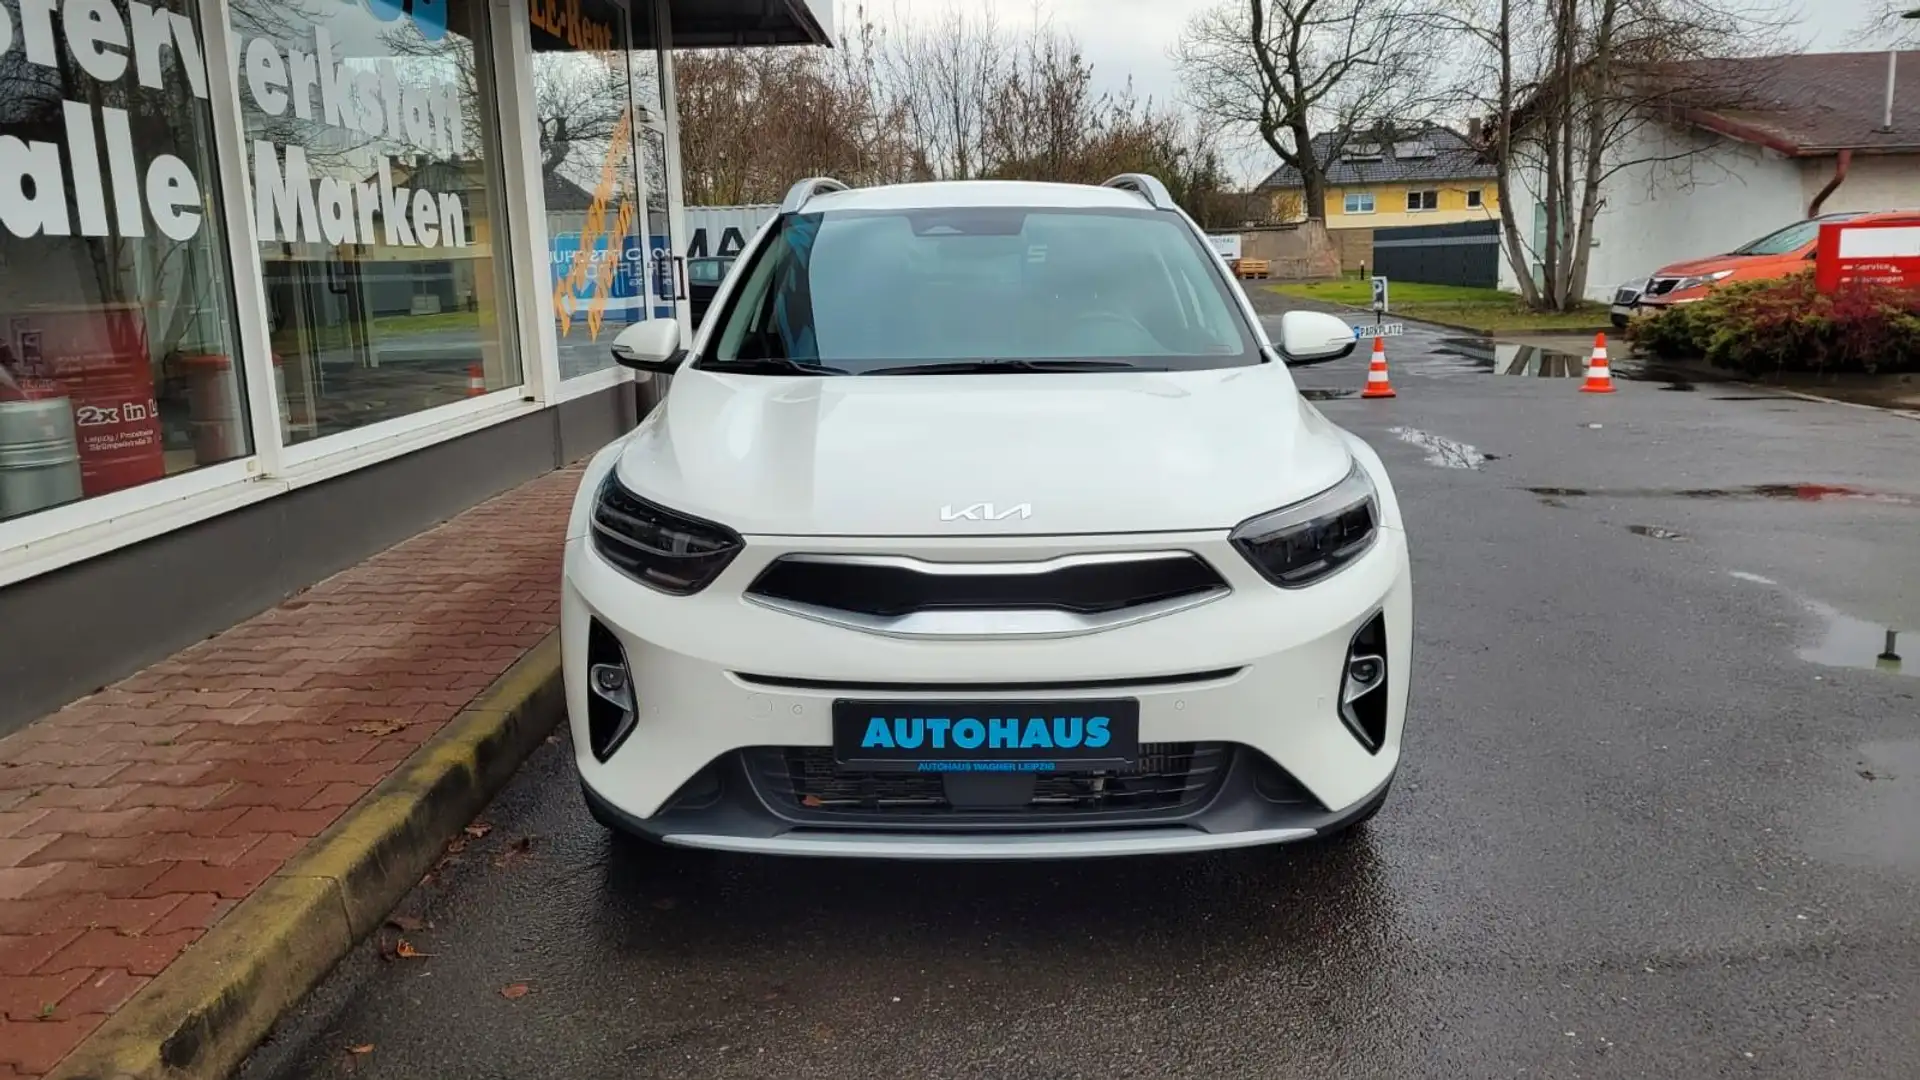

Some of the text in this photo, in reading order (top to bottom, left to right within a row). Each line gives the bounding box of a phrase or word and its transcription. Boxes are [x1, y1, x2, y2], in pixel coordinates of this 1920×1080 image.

[254, 140, 467, 248] Marken
[1360, 323, 1402, 337] PARKPLATZ
[78, 405, 119, 426] 2x
[123, 402, 145, 421] in
[940, 502, 1032, 521] KIA
[861, 717, 1112, 749] AUTOHAUS
[917, 762, 971, 773] AUTOHAUS
[1018, 762, 1057, 773] LEIPZIG
